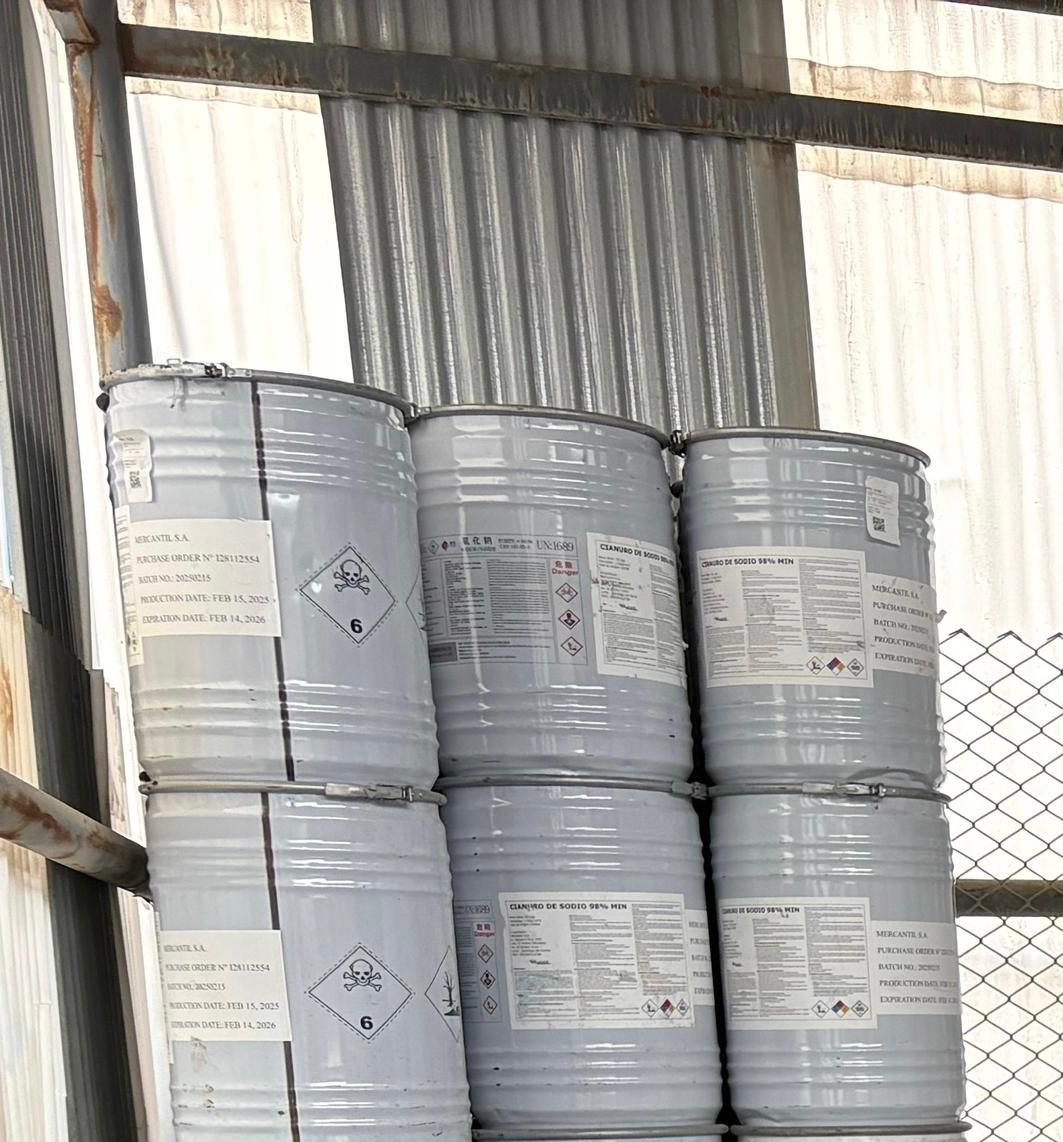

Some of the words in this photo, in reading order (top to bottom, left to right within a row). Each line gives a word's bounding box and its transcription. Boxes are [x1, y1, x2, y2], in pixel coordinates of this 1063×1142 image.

[536, 540, 574, 551] UN:1689
[599, 543, 633, 556] CIANURO
[634, 549, 643, 557] DE
[172, 554, 200, 562] ORDER
[552, 568, 579, 576] Danger
[185, 594, 210, 603] DATE:
[213, 593, 230, 603] FEB
[183, 614, 207, 623] DATE:
[209, 614, 227, 623] FEB
[245, 615, 266, 624] 2026
[350, 617, 363, 635] 6
[877, 930, 917, 938] MERCANTIL
[878, 947, 913, 955] PURCHASE
[880, 980, 923, 988] PRODUCTION
[880, 996, 920, 1004] EXPIRATION
[227, 1002, 243, 1010] FEB
[260, 1002, 279, 1010] 2025
[224, 1021, 240, 1029] FEB
[244, 1021, 255, 1030] 14,
[257, 1021, 276, 1030] 2026
[360, 1015, 374, 1030] 6
